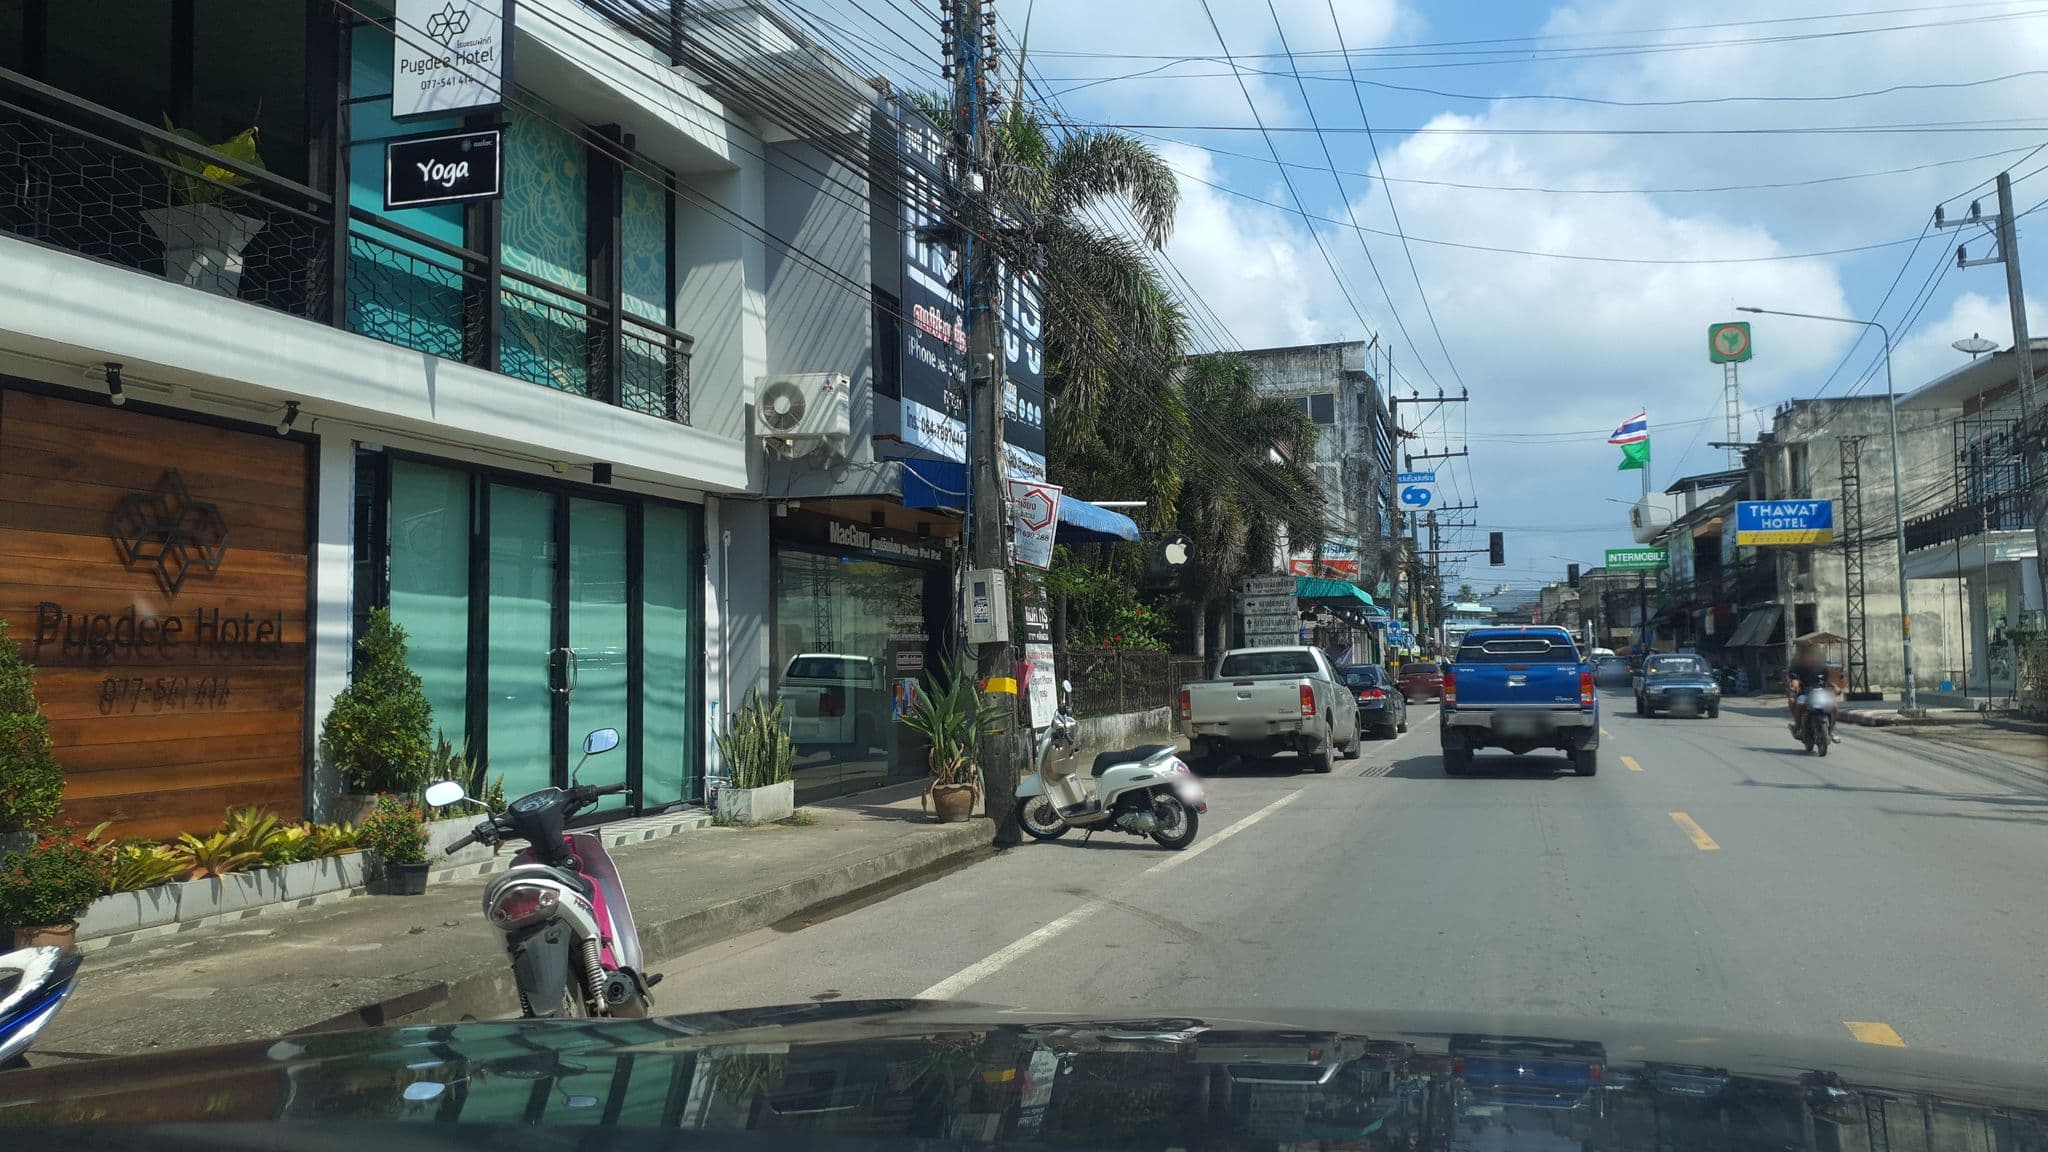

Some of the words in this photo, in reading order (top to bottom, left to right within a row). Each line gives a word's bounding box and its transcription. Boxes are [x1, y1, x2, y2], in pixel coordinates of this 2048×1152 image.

[400, 56, 451, 75] Pugdee
[456, 46, 494, 67] Hotel
[420, 76, 456, 90] 077-541
[416, 158, 469, 187] Yoga
[907, 334, 937, 369] iPhone
[1749, 503, 1818, 517] THAWAT
[1761, 518, 1807, 529] HOTEL
[829, 521, 871, 549] MacGuru
[1608, 551, 1667, 563] INTERMOBILE
[36, 602, 183, 658] Pugdee
[194, 607, 284, 650] Hotel
